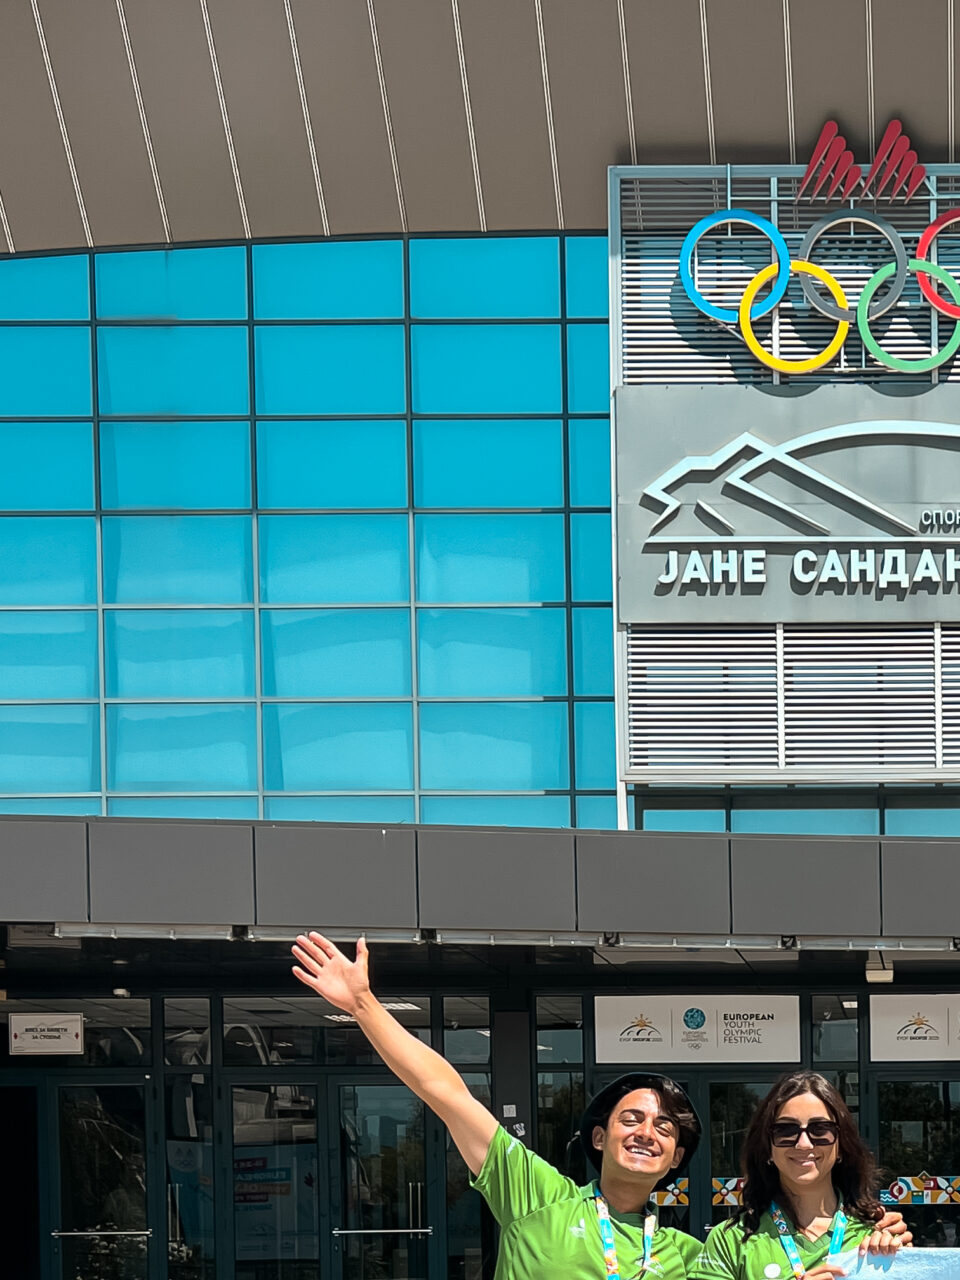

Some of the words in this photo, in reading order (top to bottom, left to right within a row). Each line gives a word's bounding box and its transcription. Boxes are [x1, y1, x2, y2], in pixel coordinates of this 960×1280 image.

[658, 549, 767, 584] ЈАНЕ
[723, 1013, 775, 1021] EUROPEAN
[723, 1021, 755, 1029] YOUTH
[723, 1028, 763, 1037] OLYMPIC
[723, 1036, 763, 1044] FESTIVAL
